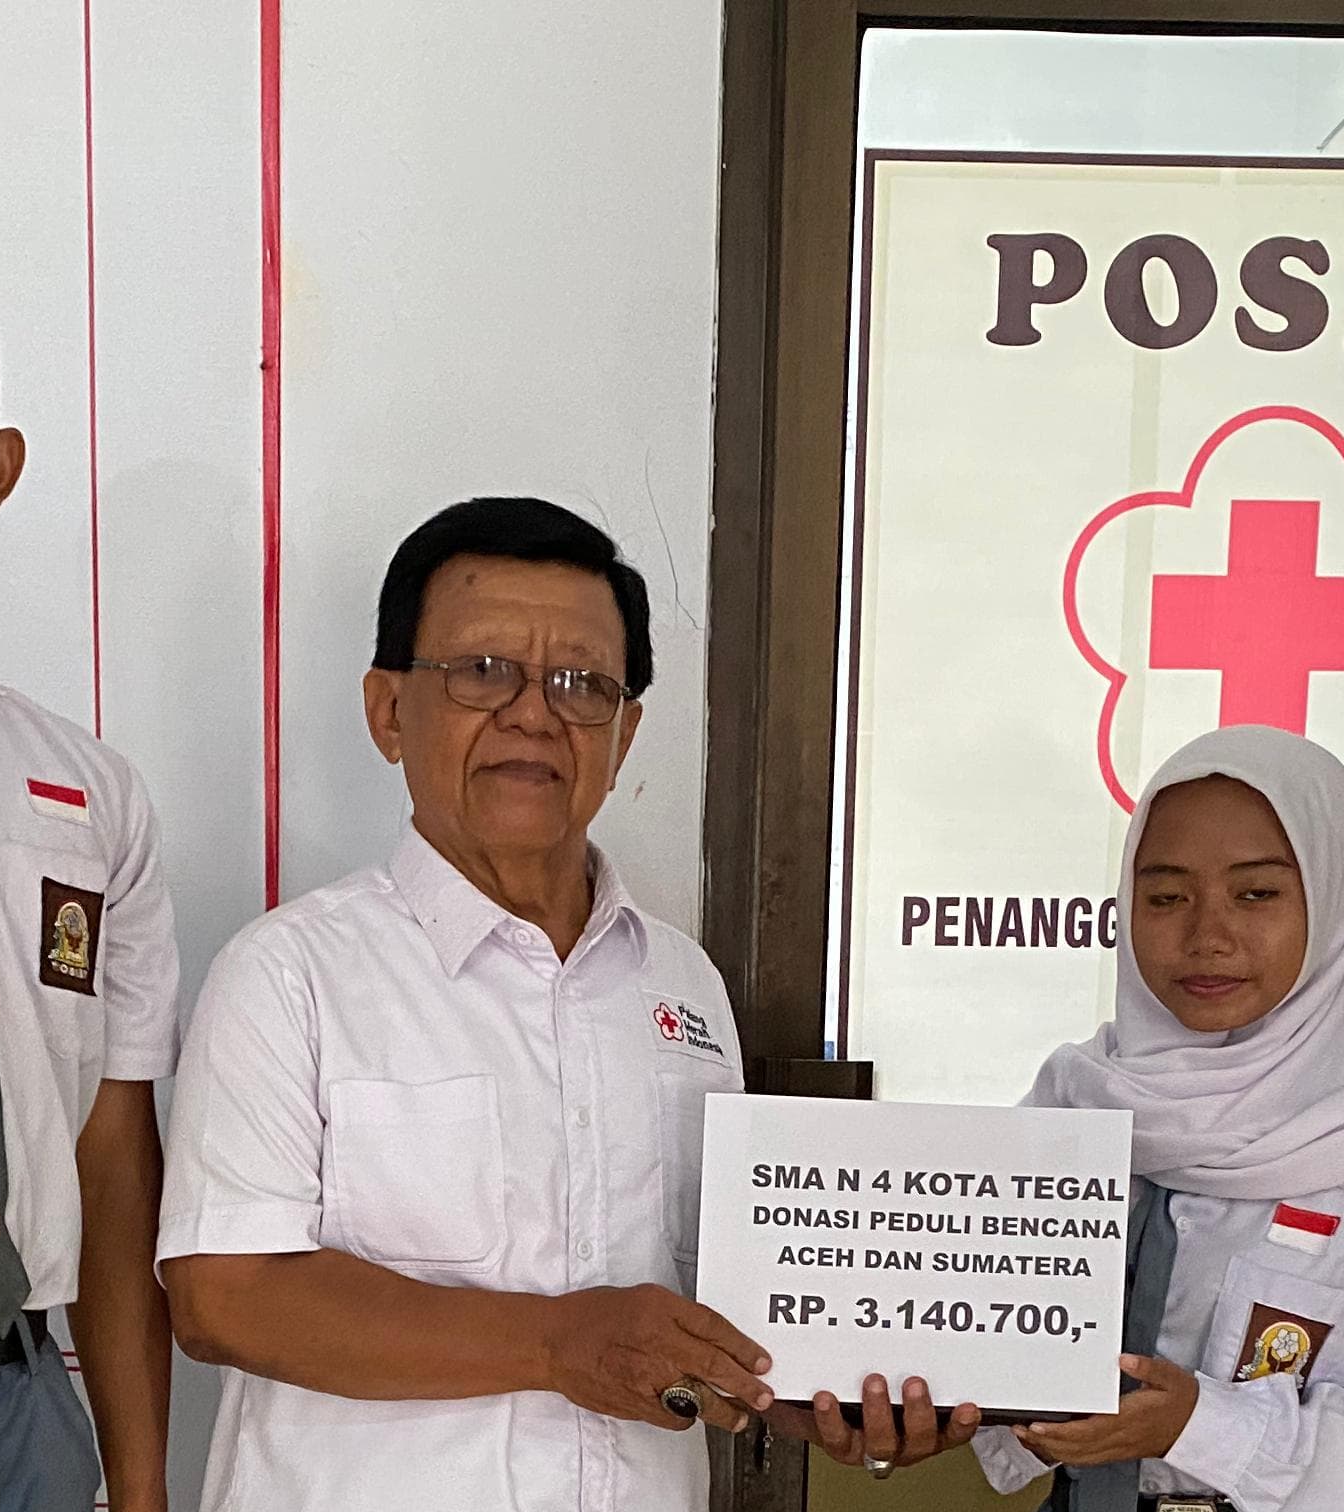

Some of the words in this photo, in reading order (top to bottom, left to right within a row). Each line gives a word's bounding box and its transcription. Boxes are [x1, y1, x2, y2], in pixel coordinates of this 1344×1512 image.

[902, 896, 1117, 949] PENANGG
[752, 1164, 825, 1190] SMA
[838, 1169, 859, 1192] N
[872, 1170, 891, 1193] 4
[904, 1172, 999, 1197] KOTA
[1011, 1176, 1124, 1201] TEGAL
[754, 1206, 859, 1229] DONASI
[870, 1211, 971, 1234] PEDULI
[982, 1216, 1121, 1239] BENCANA
[778, 1246, 854, 1267] ACEH
[865, 1250, 922, 1270] DAN
[932, 1253, 1091, 1277] SUMATERA
[769, 1294, 837, 1326] RP.
[855, 1298, 1096, 1343] 3.140.700,-
